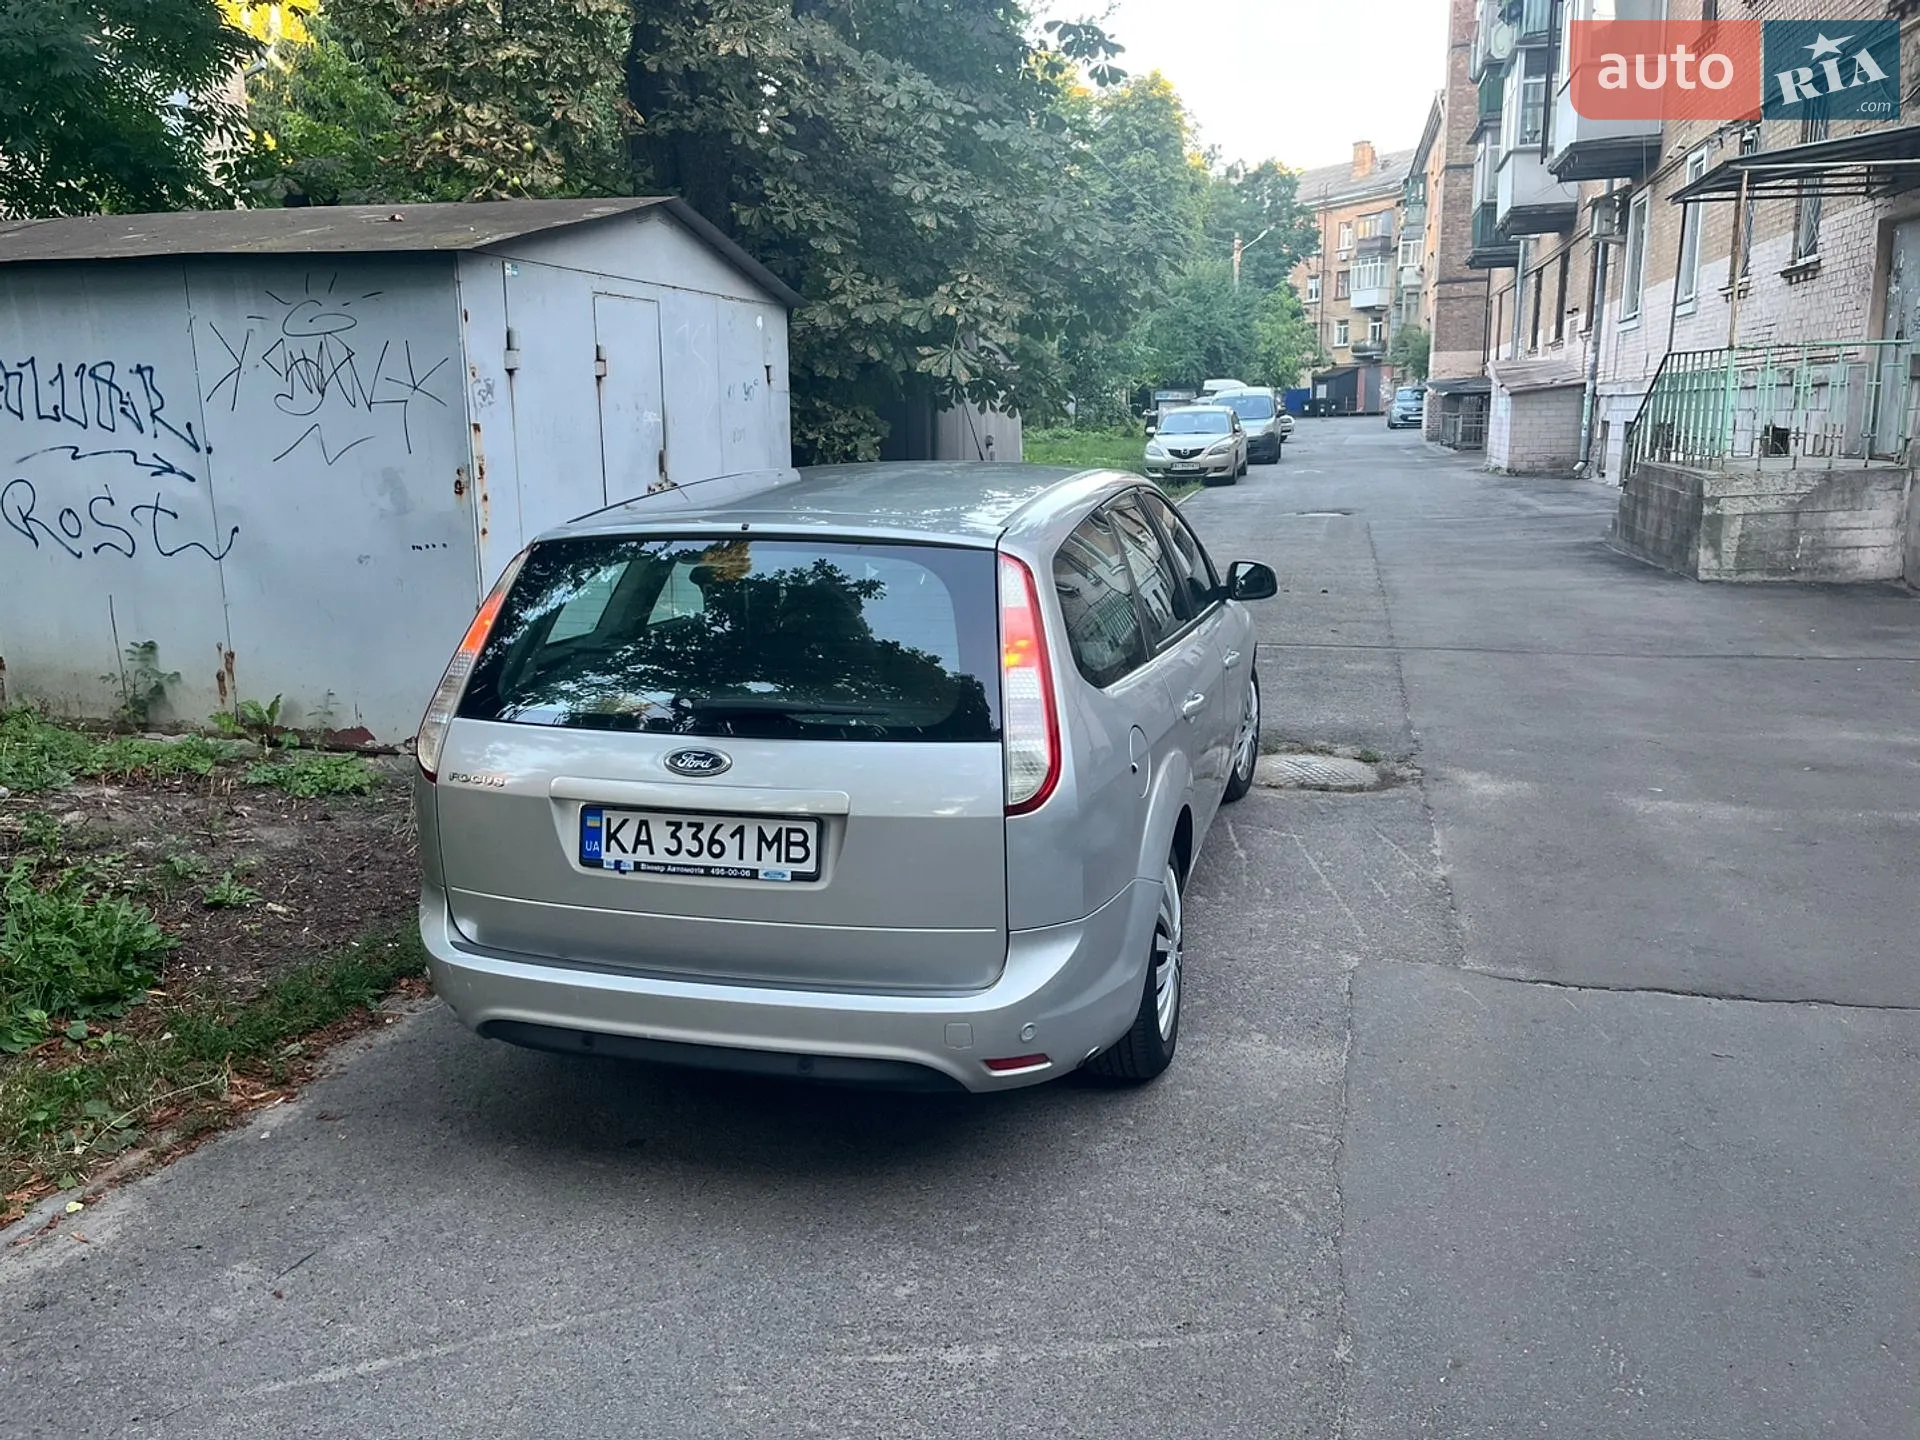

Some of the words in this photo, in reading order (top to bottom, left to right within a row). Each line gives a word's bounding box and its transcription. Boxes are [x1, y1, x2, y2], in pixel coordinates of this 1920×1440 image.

[677, 752, 713, 770] Ford
[447, 770, 506, 788] FOCUS
[585, 840, 601, 852] UA
[604, 817, 656, 856] KA
[663, 820, 746, 861] 3361
[756, 824, 812, 865] MB
